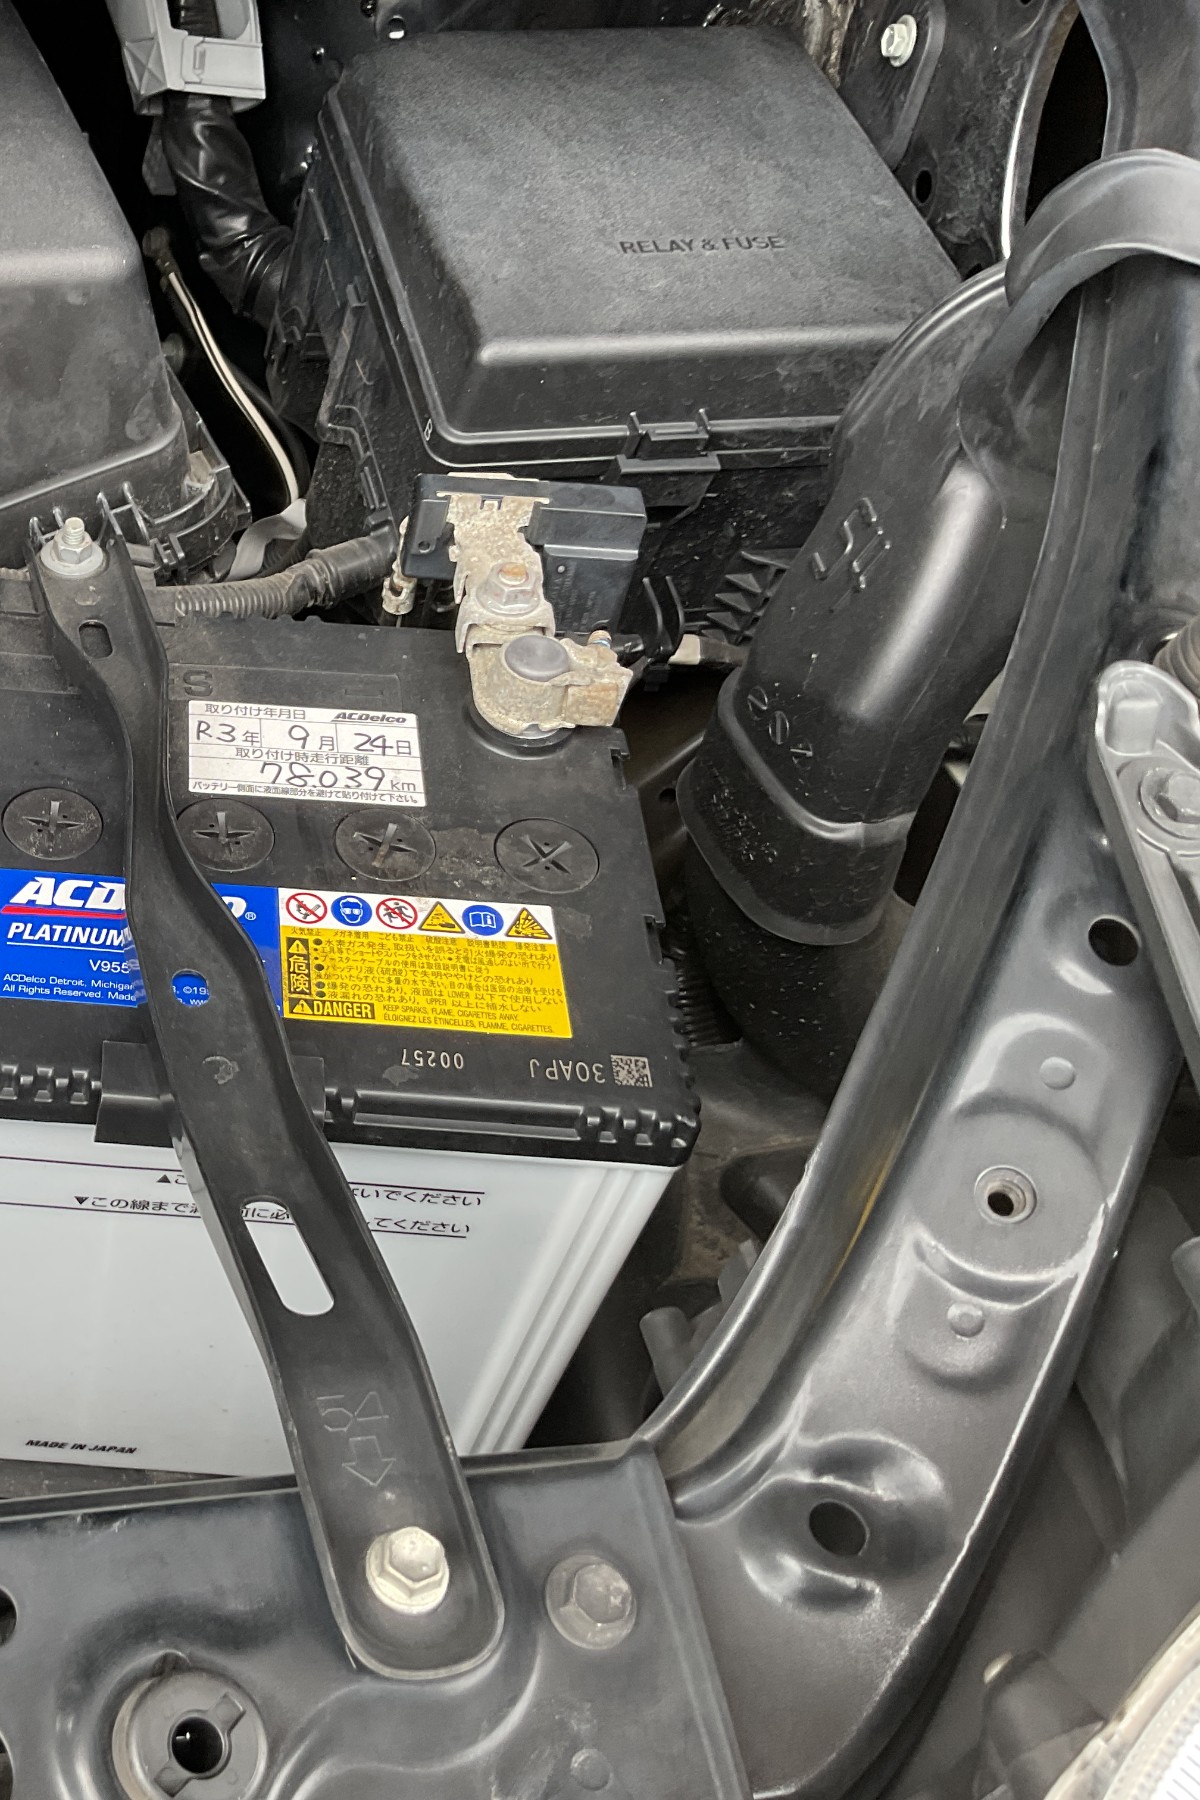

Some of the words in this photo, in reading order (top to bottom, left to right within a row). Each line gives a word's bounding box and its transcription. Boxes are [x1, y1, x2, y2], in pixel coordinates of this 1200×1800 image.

[619, 239, 694, 254] RELAY
[701, 238, 715, 251] &
[722, 236, 785, 250] FUSE
[205, 703, 306, 720] 取り付け年月日
[333, 712, 407, 724] ACDelco
[242, 731, 261, 744] 年
[288, 725, 310, 749] 9
[318, 736, 335, 751] 月
[354, 733, 393, 756] 24
[396, 740, 412, 755] 日
[236, 748, 369, 766] 取り付け時走行距離
[391, 780, 416, 791] km
[8, 922, 125, 947] PLATINUM
[291, 928, 321, 937] 火気禁止
[333, 931, 369, 940] メガネ着用
[379, 933, 414, 943] こども禁止
[426, 936, 457, 946] 硫酸注意
[515, 943, 547, 952] 爆発注意
[3, 974, 46, 984] ACDelco
[49, 976, 87, 988] Detroit,
[289, 954, 310, 993] 危険
[3, 984, 15, 993] All
[18, 985, 50, 996] Rights
[448, 990, 470, 999] LOWER
[314, 1001, 372, 1018] DANGER
[426, 998, 447, 1007] UPPER
[383, 1004, 400, 1013] KEEP
[457, 1010, 497, 1019] CIGARETTES
[384, 1014, 419, 1024] ÉLOIGNEZ
[421, 1016, 433, 1024] LES
[401, 1049, 464, 1070] 00257
[367, 1217, 469, 1233] てください
[25, 1440, 68, 1449] MADE
[88, 1445, 137, 1454] JAPAN
